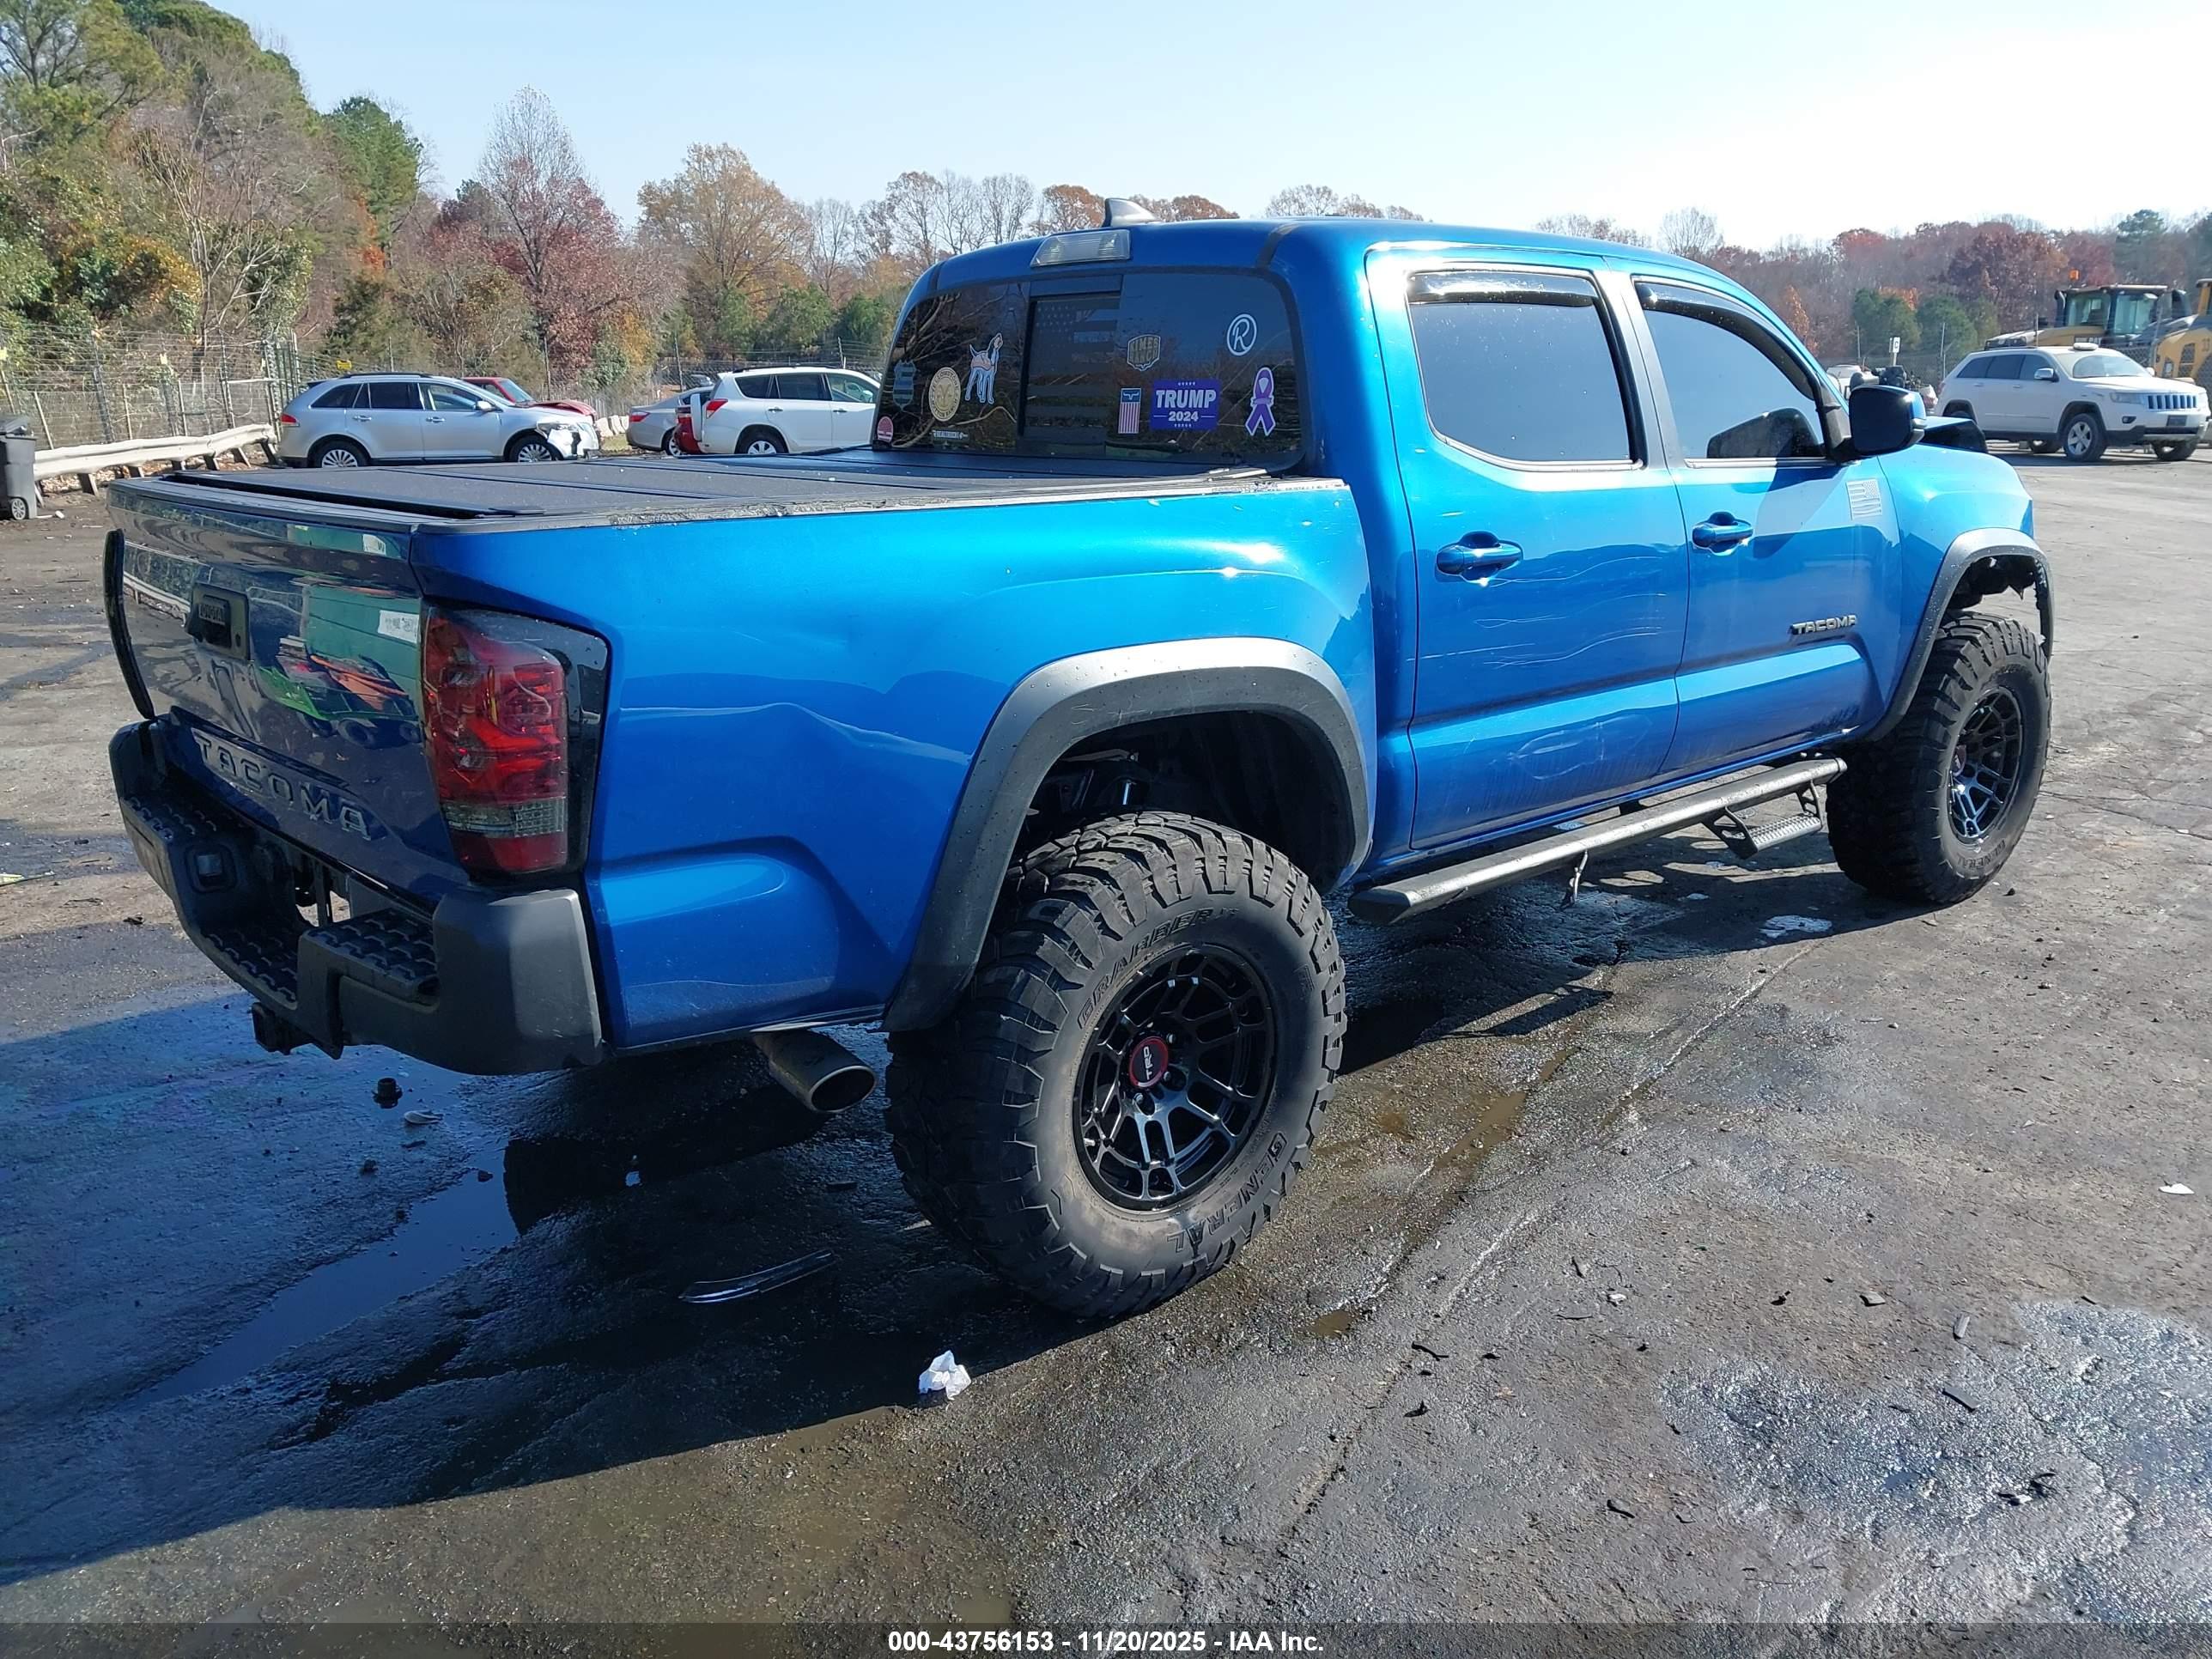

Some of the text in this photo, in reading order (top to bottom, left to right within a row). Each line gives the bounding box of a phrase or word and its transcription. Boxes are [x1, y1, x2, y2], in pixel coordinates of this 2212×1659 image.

[1156, 389, 1217, 409] TRUMP
[1168, 410, 1199, 422] 2024
[1790, 614, 1858, 635] TACOMA
[193, 733, 373, 842] TACOMA
[1077, 907, 1214, 1030] GRABBER
[1143, 1046, 1153, 1080] TRD
[1167, 1131, 1287, 1254] GENERAL
